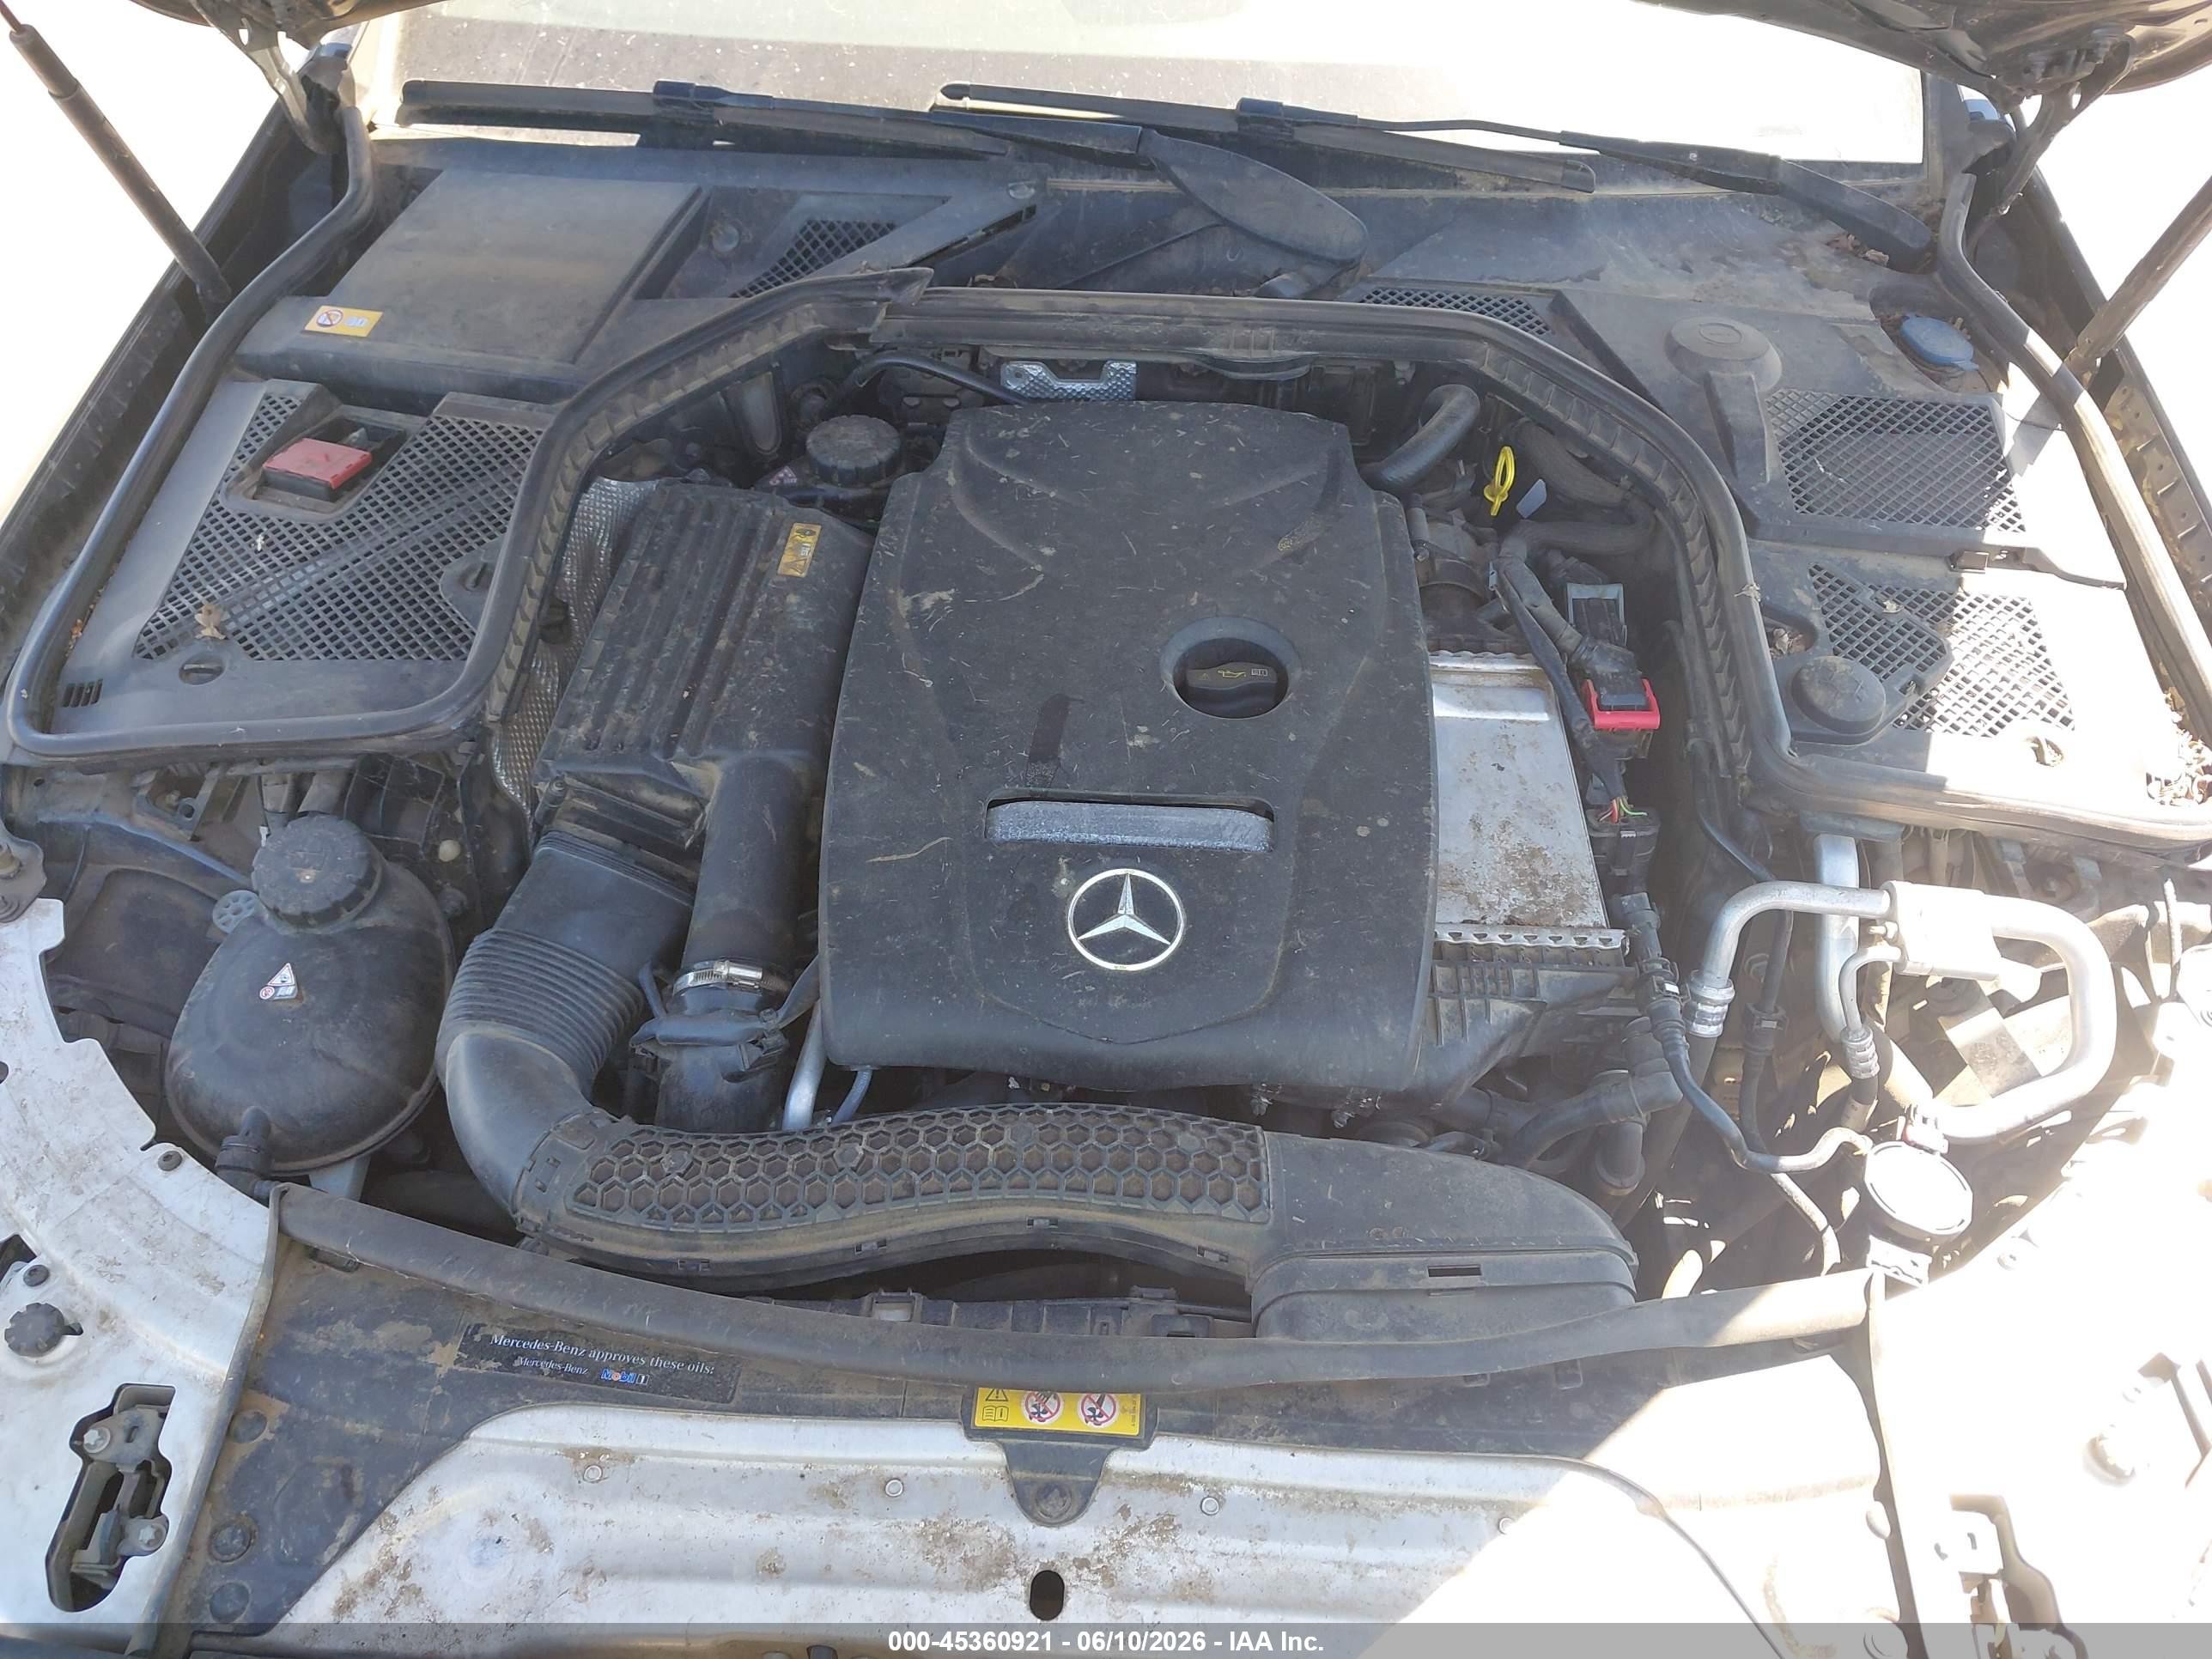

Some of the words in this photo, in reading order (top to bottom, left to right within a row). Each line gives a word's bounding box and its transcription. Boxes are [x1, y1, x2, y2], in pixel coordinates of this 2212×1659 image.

[490, 1334, 586, 1357] Mercedes-Benz
[588, 1349, 645, 1365] approves
[649, 1356, 684, 1370] these
[688, 1361, 714, 1375] oils:
[518, 1357, 589, 1375] Mercedes-Benz
[600, 1368, 636, 1383] Mobil
